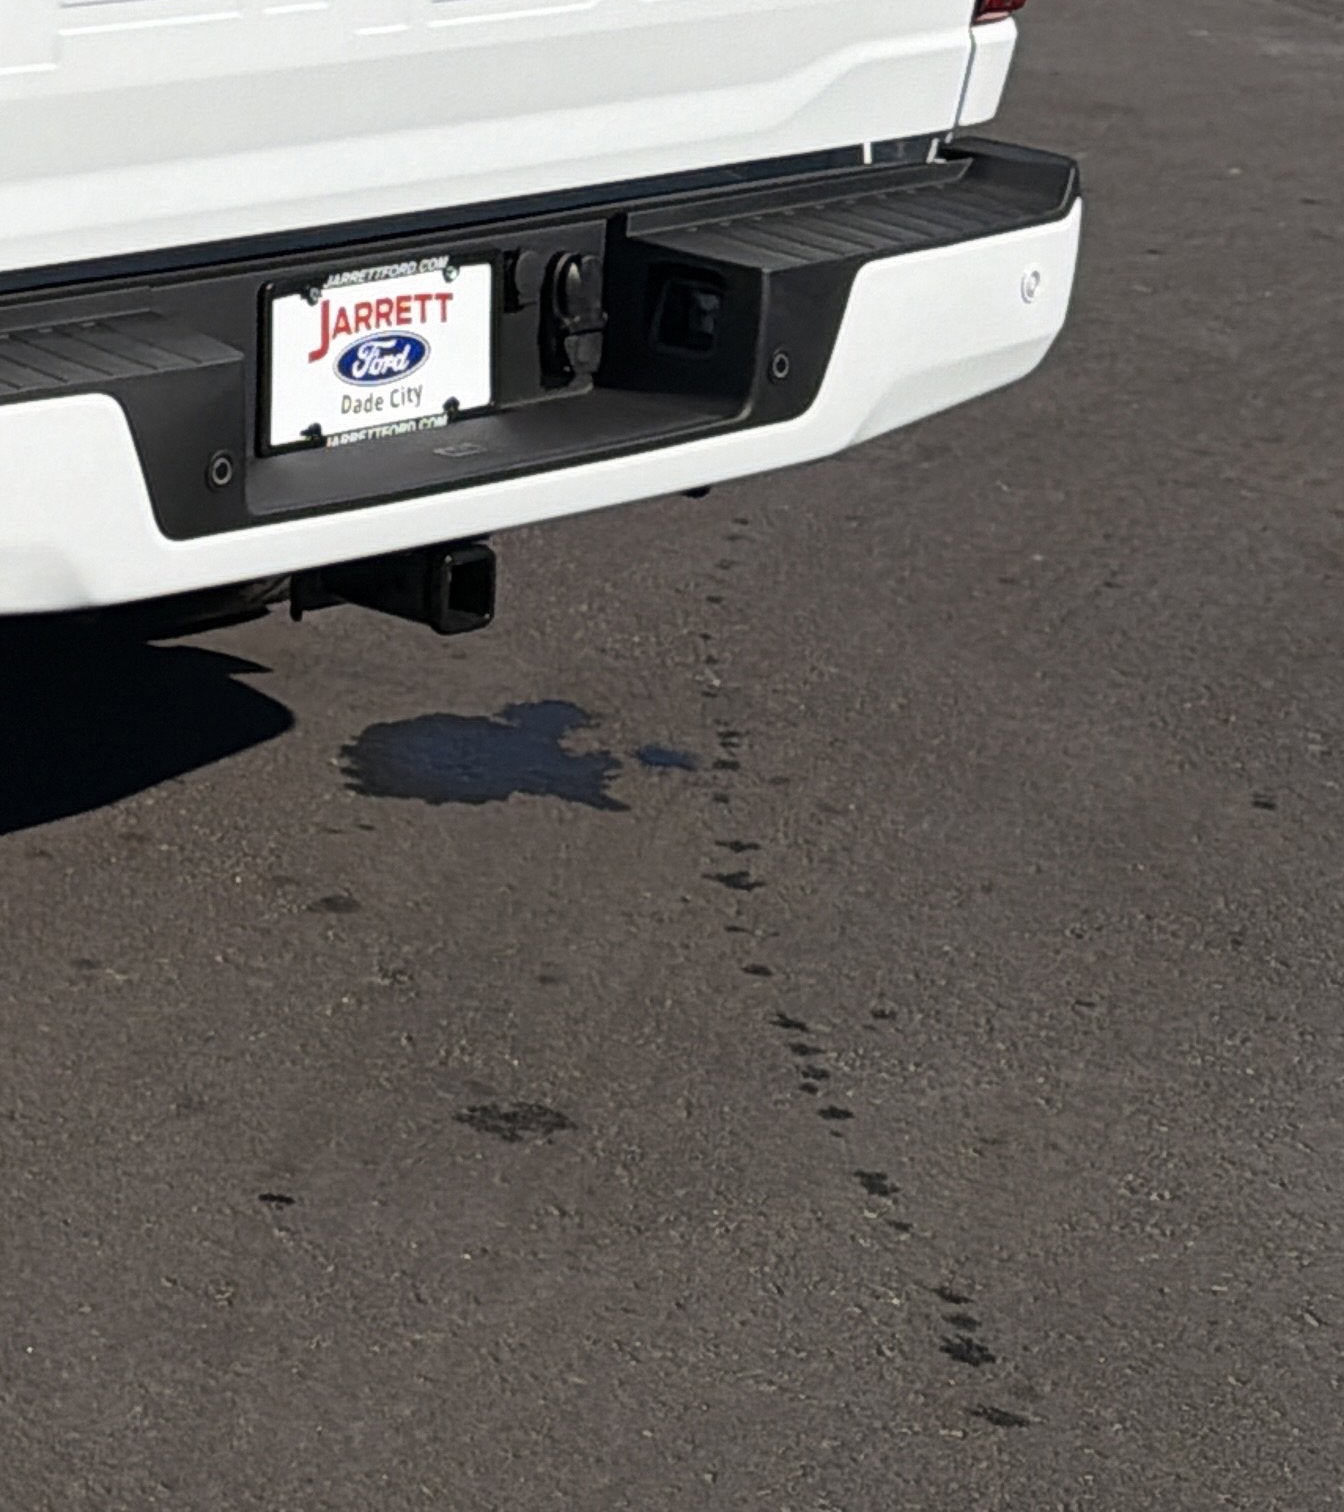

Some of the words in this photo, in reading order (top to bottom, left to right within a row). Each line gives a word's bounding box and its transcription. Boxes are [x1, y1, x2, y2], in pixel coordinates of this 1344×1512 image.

[309, 293, 453, 362] JARRETT
[351, 338, 412, 379] Ford
[340, 392, 385, 415] Dade
[389, 383, 424, 408] City
